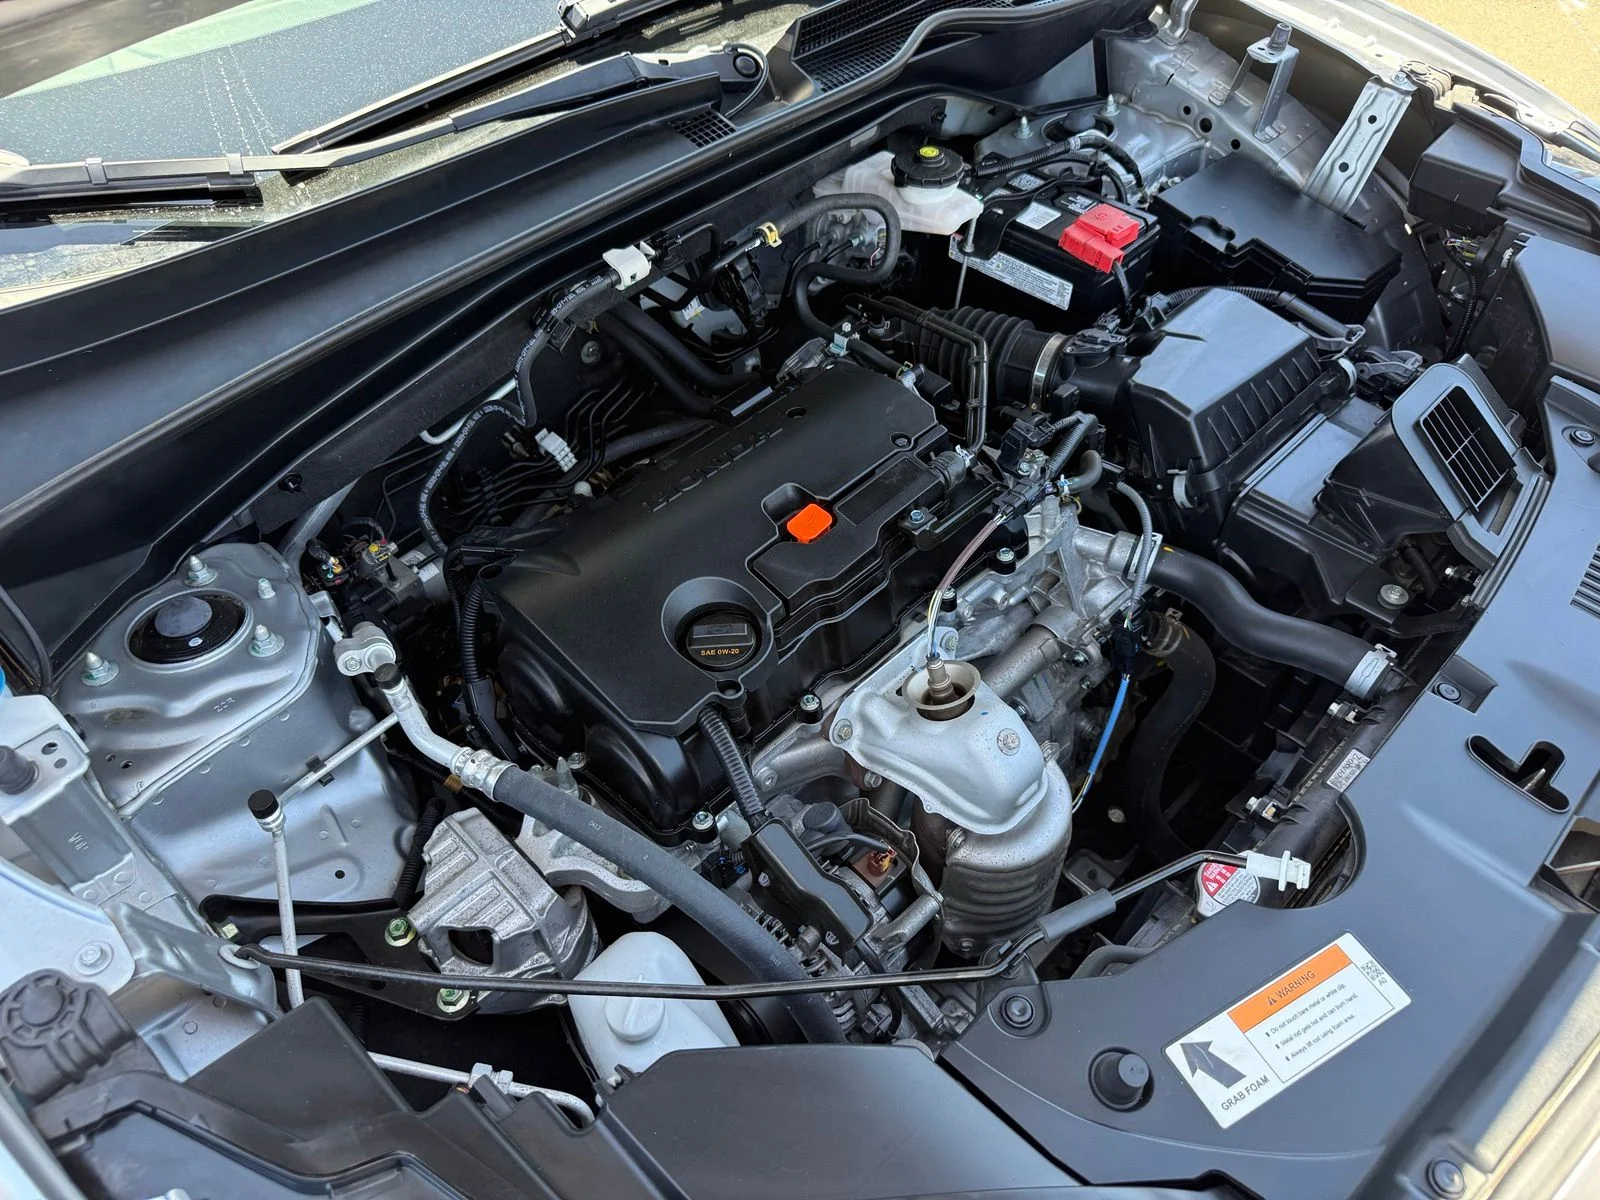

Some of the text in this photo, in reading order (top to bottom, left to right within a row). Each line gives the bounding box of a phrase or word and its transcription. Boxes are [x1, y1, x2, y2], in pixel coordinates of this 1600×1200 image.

[1275, 970, 1316, 999] WARNING
[1221, 1074, 1270, 1111] GRAB FOAM
